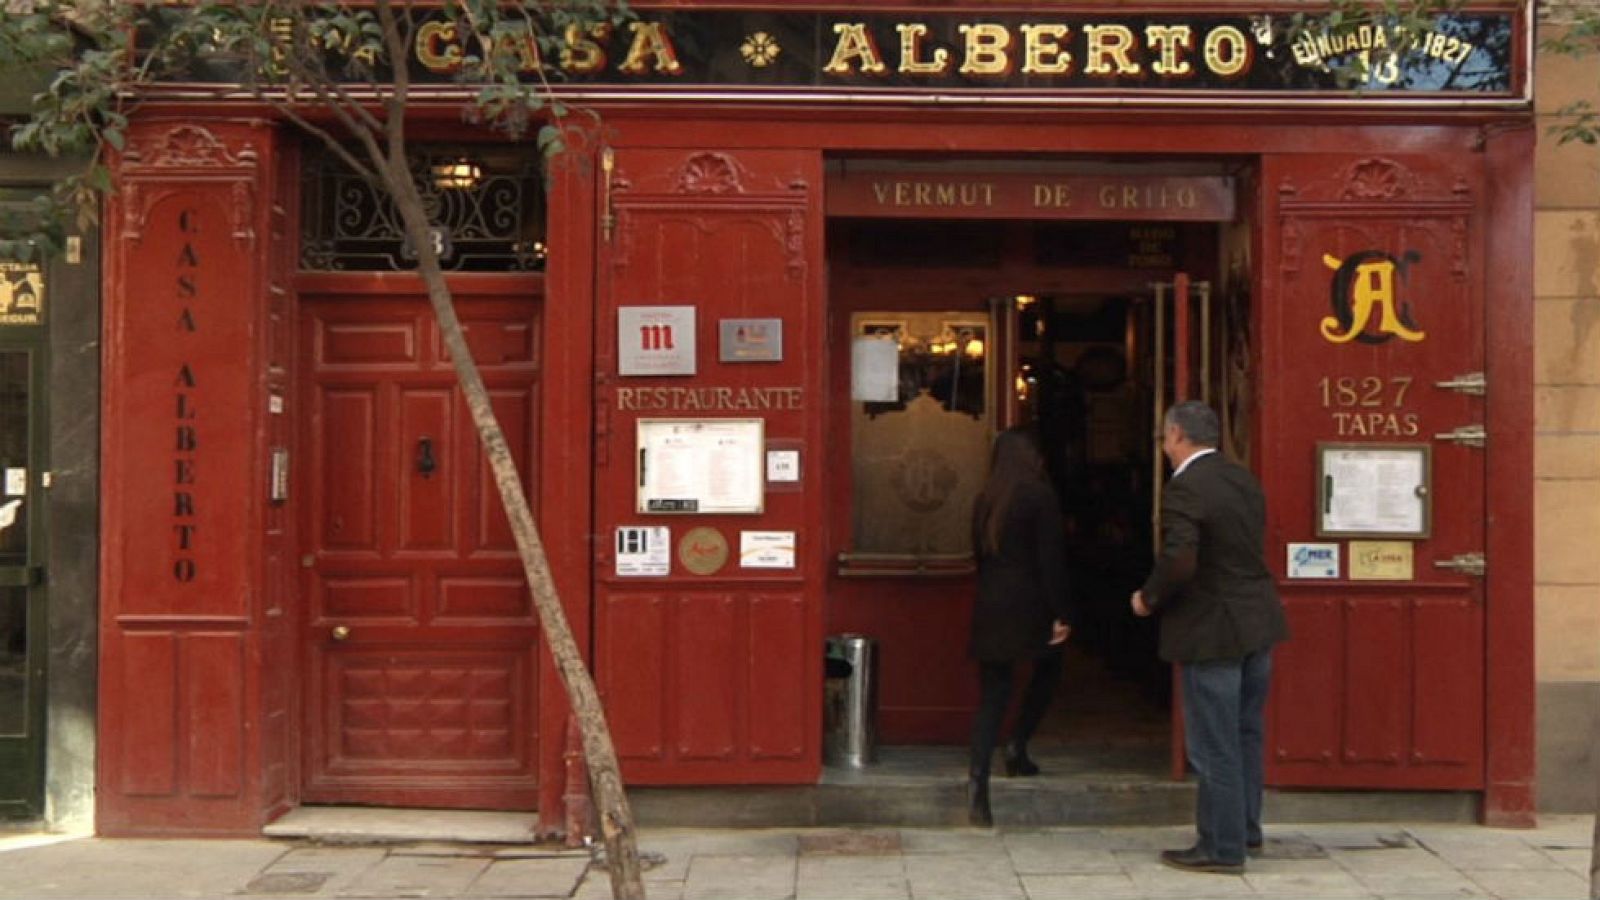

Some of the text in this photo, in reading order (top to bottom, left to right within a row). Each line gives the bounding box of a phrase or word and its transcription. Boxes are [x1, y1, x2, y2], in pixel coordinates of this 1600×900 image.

[823, 22, 1252, 77] ALBERTO
[1422, 32, 1472, 66] 1827
[873, 181, 995, 207] VERMUT
[1033, 183, 1072, 208] DE
[172, 208, 198, 583] CASA ALBERTO
[616, 386, 804, 412] RESTAURANTE
[1318, 375, 1413, 407] 1827
[1332, 412, 1419, 436] TAPAS
